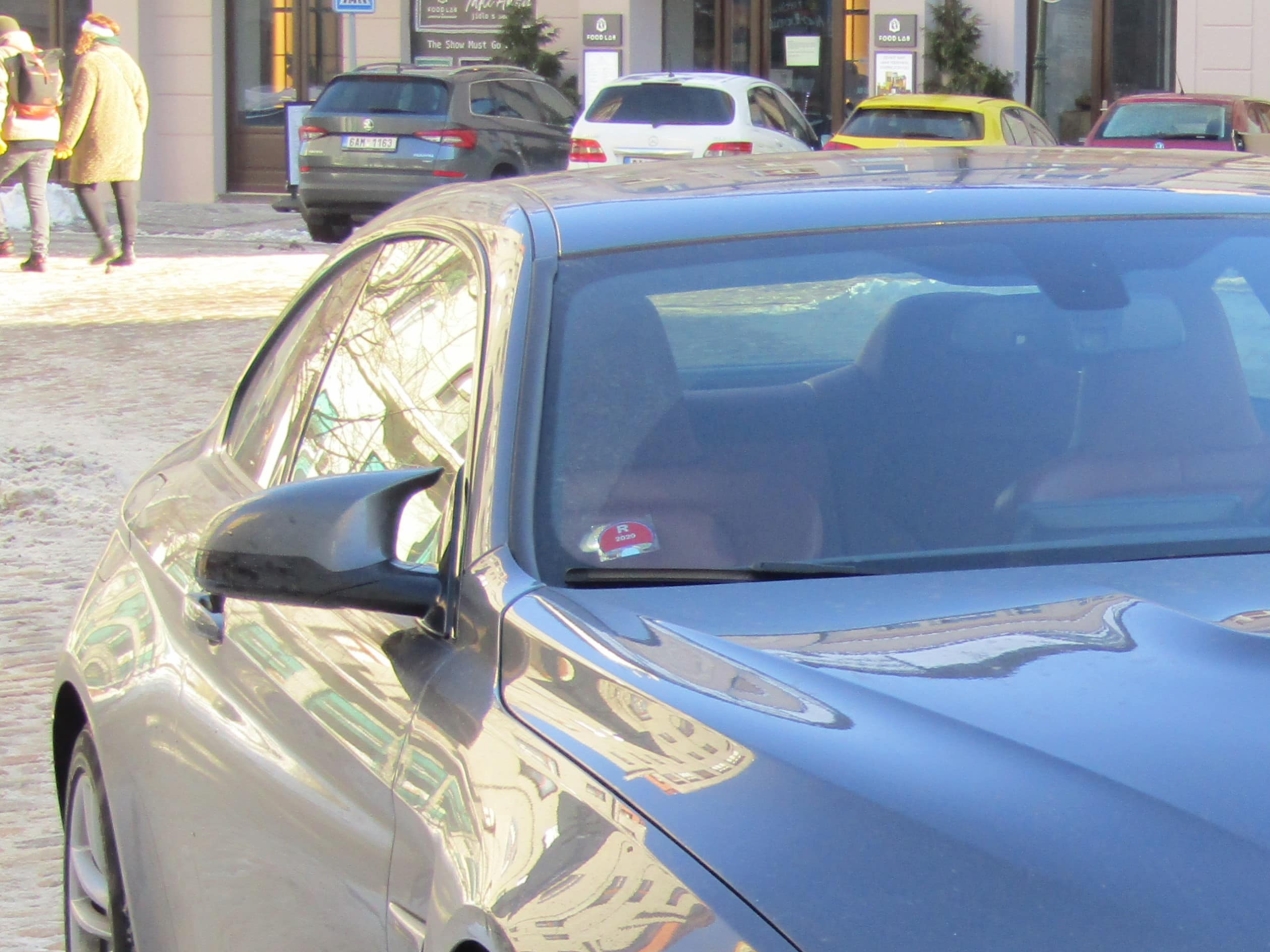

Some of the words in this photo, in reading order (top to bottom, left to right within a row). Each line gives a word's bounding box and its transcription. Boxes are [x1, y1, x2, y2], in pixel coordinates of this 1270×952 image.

[878, 34, 896, 42] FOOD
[428, 40, 442, 49] The
[445, 40, 465, 49] Show
[467, 40, 487, 49] Must
[349, 137, 366, 147] 6AM
[372, 138, 393, 148] 1163
[617, 524, 629, 534] R
[615, 533, 636, 542] 2020
